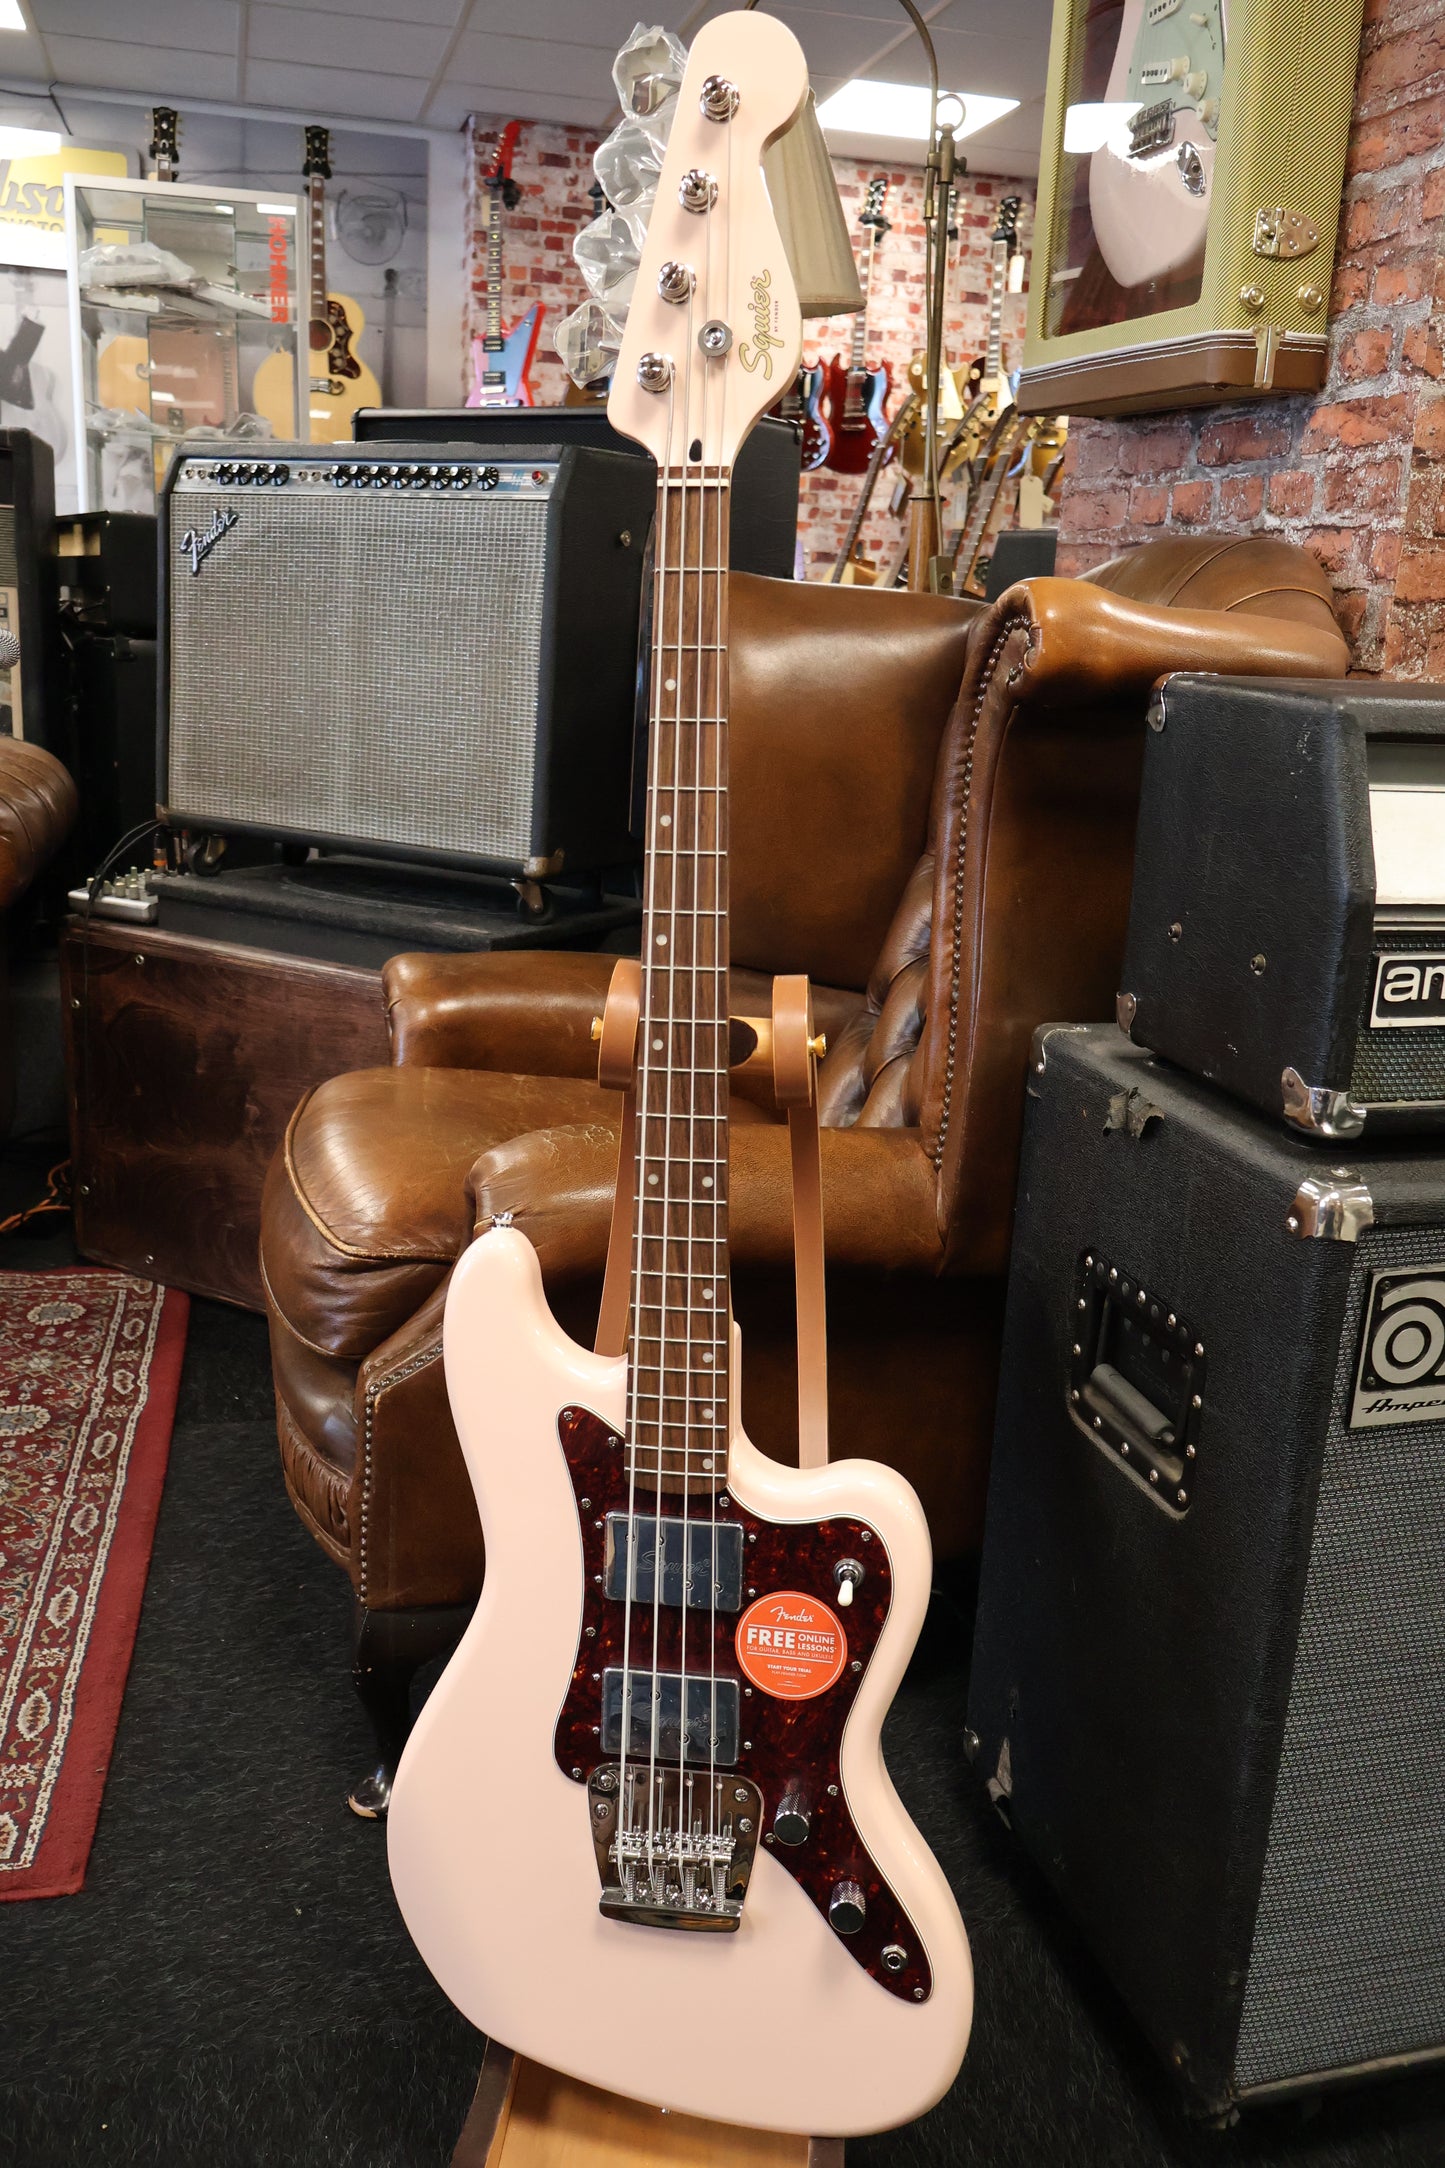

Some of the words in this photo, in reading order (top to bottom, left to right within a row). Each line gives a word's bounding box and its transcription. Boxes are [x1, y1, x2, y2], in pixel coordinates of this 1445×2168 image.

[268, 216, 289, 324] HOHNER
[738, 269, 785, 381] Squier
[180, 507, 238, 574] Fender
[1361, 1398, 1445, 1414] Ampe
[770, 1606, 814, 1623] Fender
[747, 1628, 796, 1649] FREE
[798, 1634, 835, 1645] ONLINE
